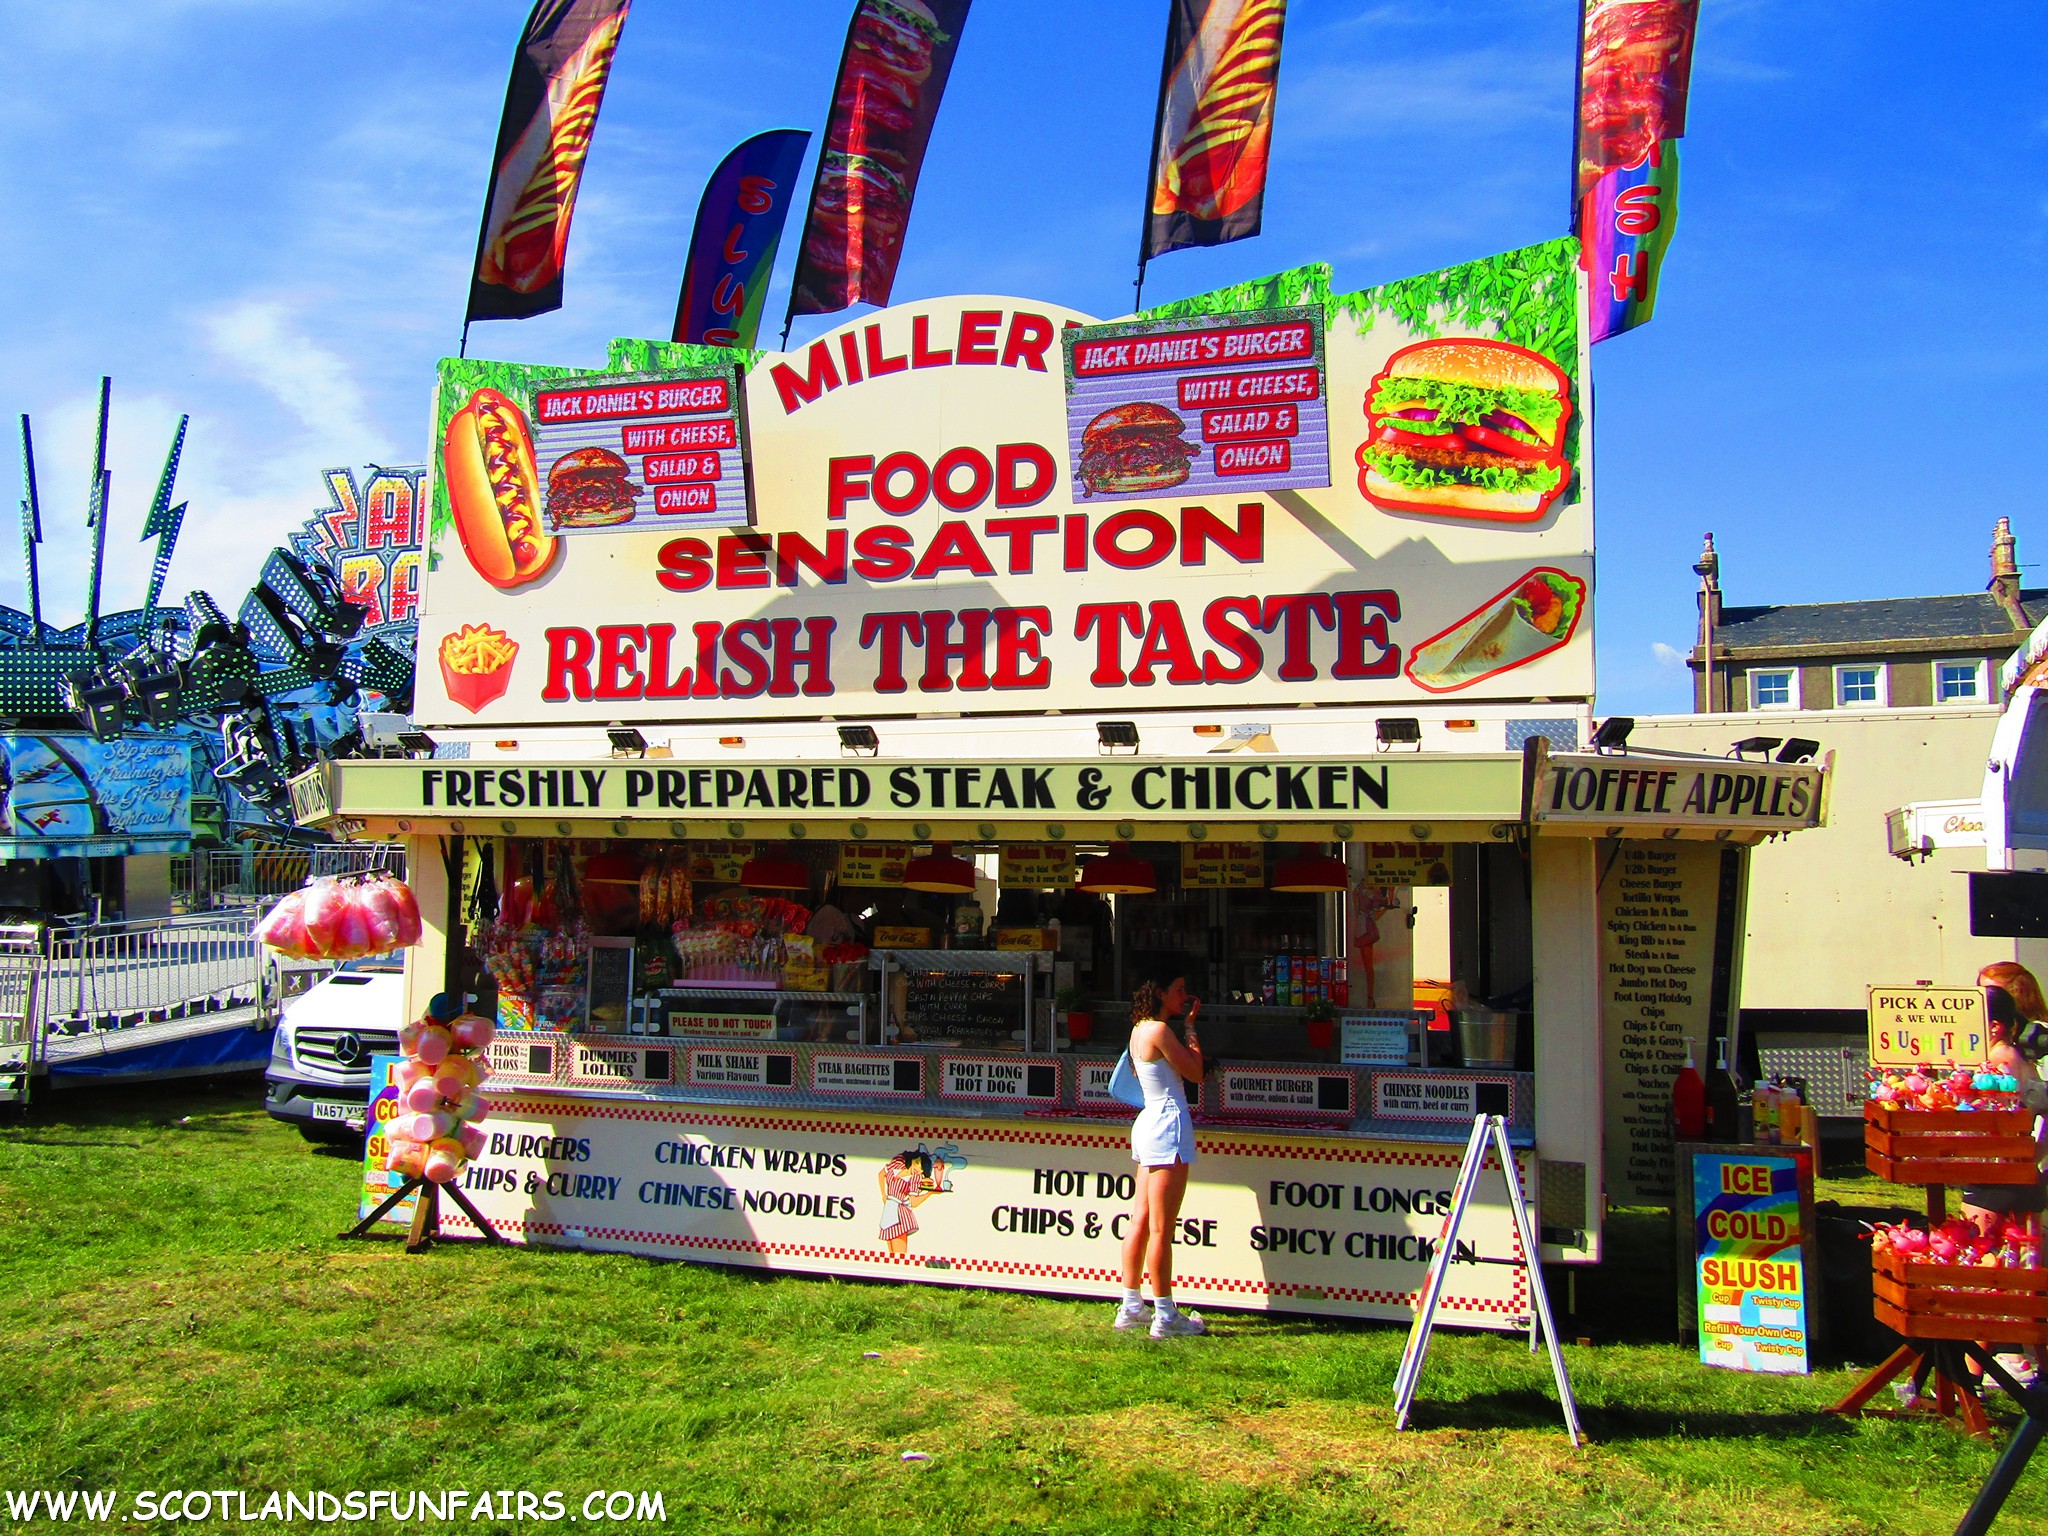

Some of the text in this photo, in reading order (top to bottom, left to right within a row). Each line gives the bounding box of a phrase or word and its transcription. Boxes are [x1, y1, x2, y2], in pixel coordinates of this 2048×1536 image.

[1081, 328, 1305, 370] JACK DANIEL'S BURGER
[769, 310, 1083, 415] MILLER
[1184, 373, 1313, 403] WITH CHEESE,
[544, 385, 722, 418] JACK DANIEL'S BURGER
[1209, 409, 1292, 435] SALAD &
[628, 424, 731, 448] WITH CHEESE,
[649, 456, 715, 478] SALAD &
[1220, 445, 1283, 469] ONION
[827, 442, 1057, 520] FOOD
[660, 488, 710, 508] ONION
[656, 503, 1265, 593] SENSATION
[541, 589, 1401, 703] RELISH THE TASTE
[422, 765, 1389, 810] FRESHLY PREPARED STEAK & CHICKEN
[1551, 767, 1810, 818] TOFFEE APPLES
[1615, 906, 1648, 917] Chicken
[1633, 921, 1666, 931] Chicken
[1640, 1006, 1665, 1018] Chips
[1879, 997, 1974, 1010] PICK A CUP
[672, 1017, 772, 1029] PLEASE DO NOT TOUCH
[1623, 1021, 1647, 1032] Chips
[1895, 1015, 1957, 1024] & WE WILL
[1622, 1035, 1647, 1046] Chips
[1880, 1031, 1979, 1058] SLUSH IT UP
[493, 1045, 519, 1057] FLOSS
[580, 1050, 637, 1063] DUMMIES
[1619, 1049, 1644, 1060] Chips
[493, 1058, 519, 1070] FLOSS
[583, 1063, 633, 1077] LOLLIES
[697, 1054, 759, 1070] MILK SHAKE
[818, 1062, 890, 1076] STEAK BAGUETTES
[949, 1063, 1022, 1079] FOOT LONG
[696, 1069, 759, 1082] Various Flavours
[1230, 1077, 1313, 1093] GOURMET BURGER
[955, 1078, 1016, 1094] HOT DOG
[1383, 1083, 1469, 1099] CHINESE NOODLES
[317, 1104, 343, 1118] NA67
[1383, 1098, 1398, 1107] with
[490, 1133, 590, 1162] BURGERS
[654, 1141, 847, 1177] CHICKEN WRAPS
[524, 1171, 540, 1194] &
[547, 1173, 621, 1201] CURRY
[1033, 1168, 1088, 1198] HOT
[1721, 1163, 1771, 1194] ICE
[638, 1181, 855, 1220] CHINESE NOODLES
[1270, 1180, 1452, 1216] FOOT LONGS
[992, 1206, 1218, 1247] CHIPS & CESE
[1708, 1210, 1787, 1241] COLD
[1250, 1224, 1476, 1266] SPICY CHICKN
[1703, 1259, 1798, 1291] SLUSH
[1713, 1293, 1800, 1310] Cup Twisty Cup
[1704, 1322, 1803, 1340] Refill Your Own Cup
[1715, 1339, 1804, 1356] Cup Twisty Cup
